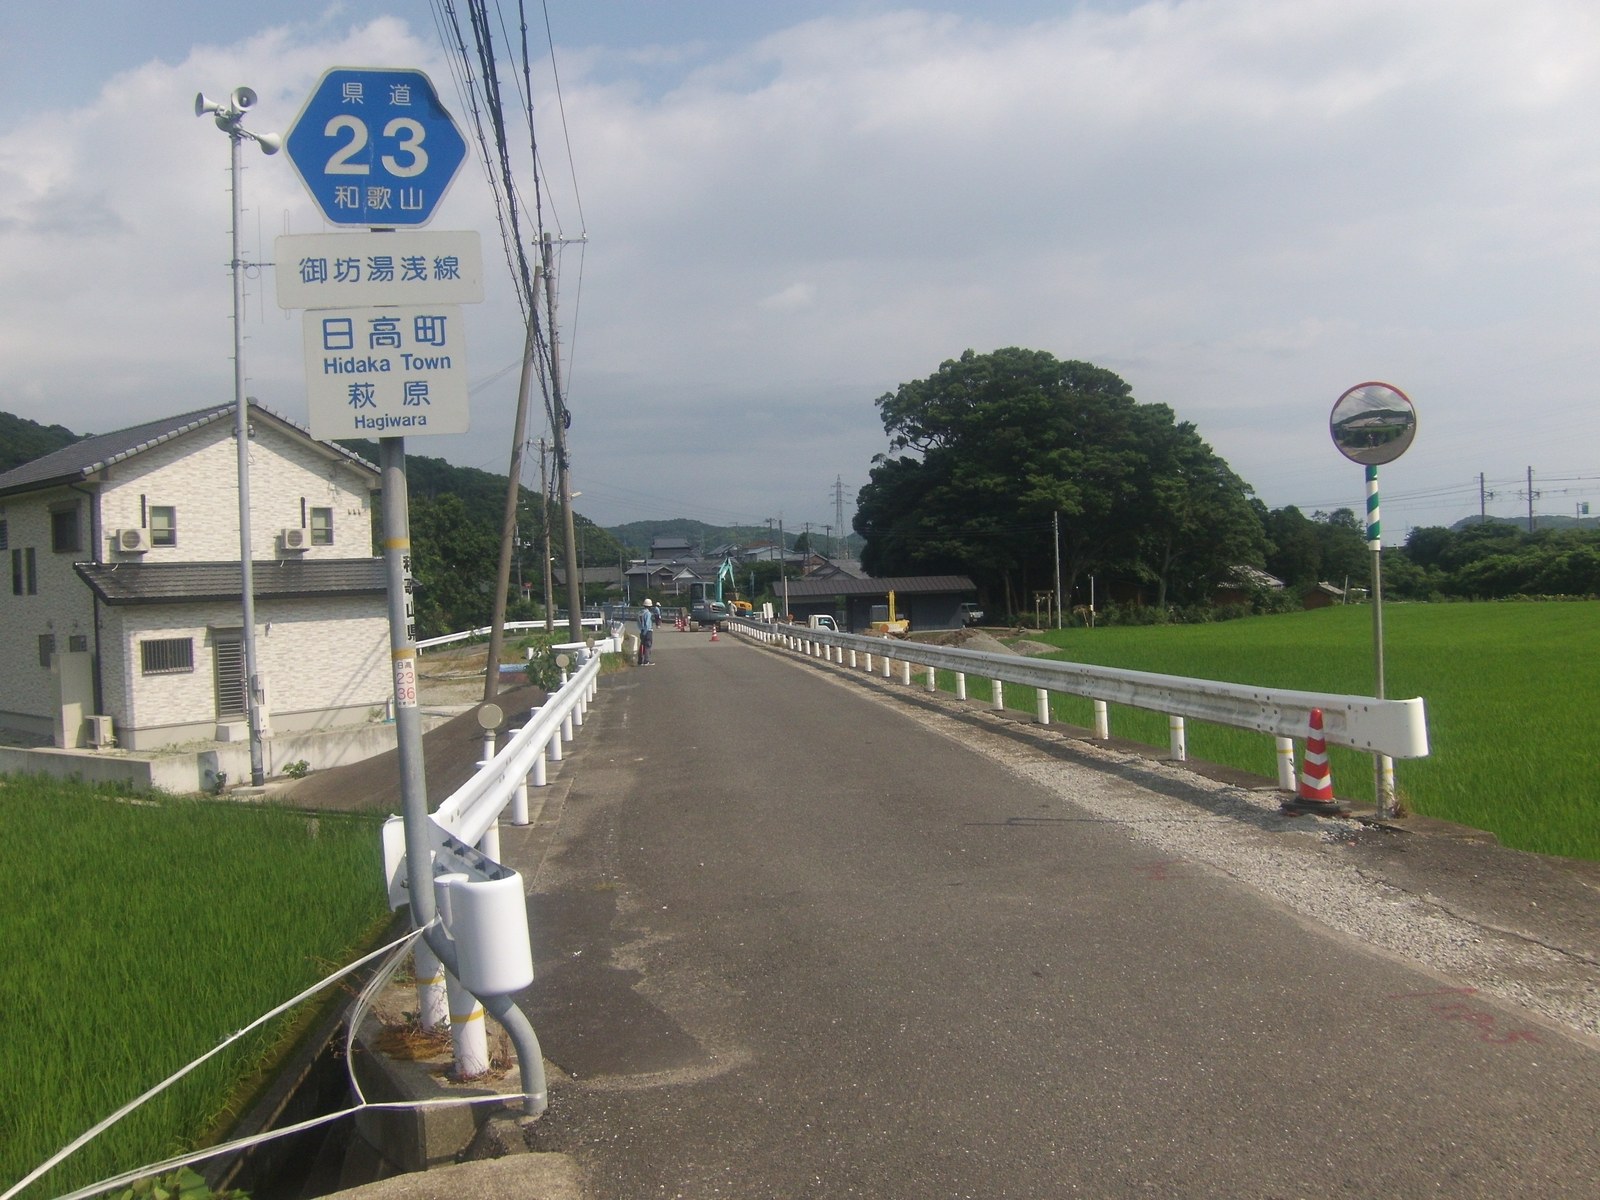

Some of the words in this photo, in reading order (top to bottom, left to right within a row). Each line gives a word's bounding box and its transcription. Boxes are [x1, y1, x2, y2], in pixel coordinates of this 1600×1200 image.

[342, 82, 412, 106] 県道
[323, 114, 429, 178] 23
[334, 185, 423, 210] 和歌山
[299, 255, 461, 284] 御坊湯浅線
[322, 314, 448, 351] 日高町
[323, 356, 391, 374] Hidaka
[400, 353, 451, 371] Town
[348, 380, 431, 409] 萩原
[354, 414, 427, 431] Hagiwara
[396, 671, 415, 685] 23
[397, 686, 416, 701] 36
